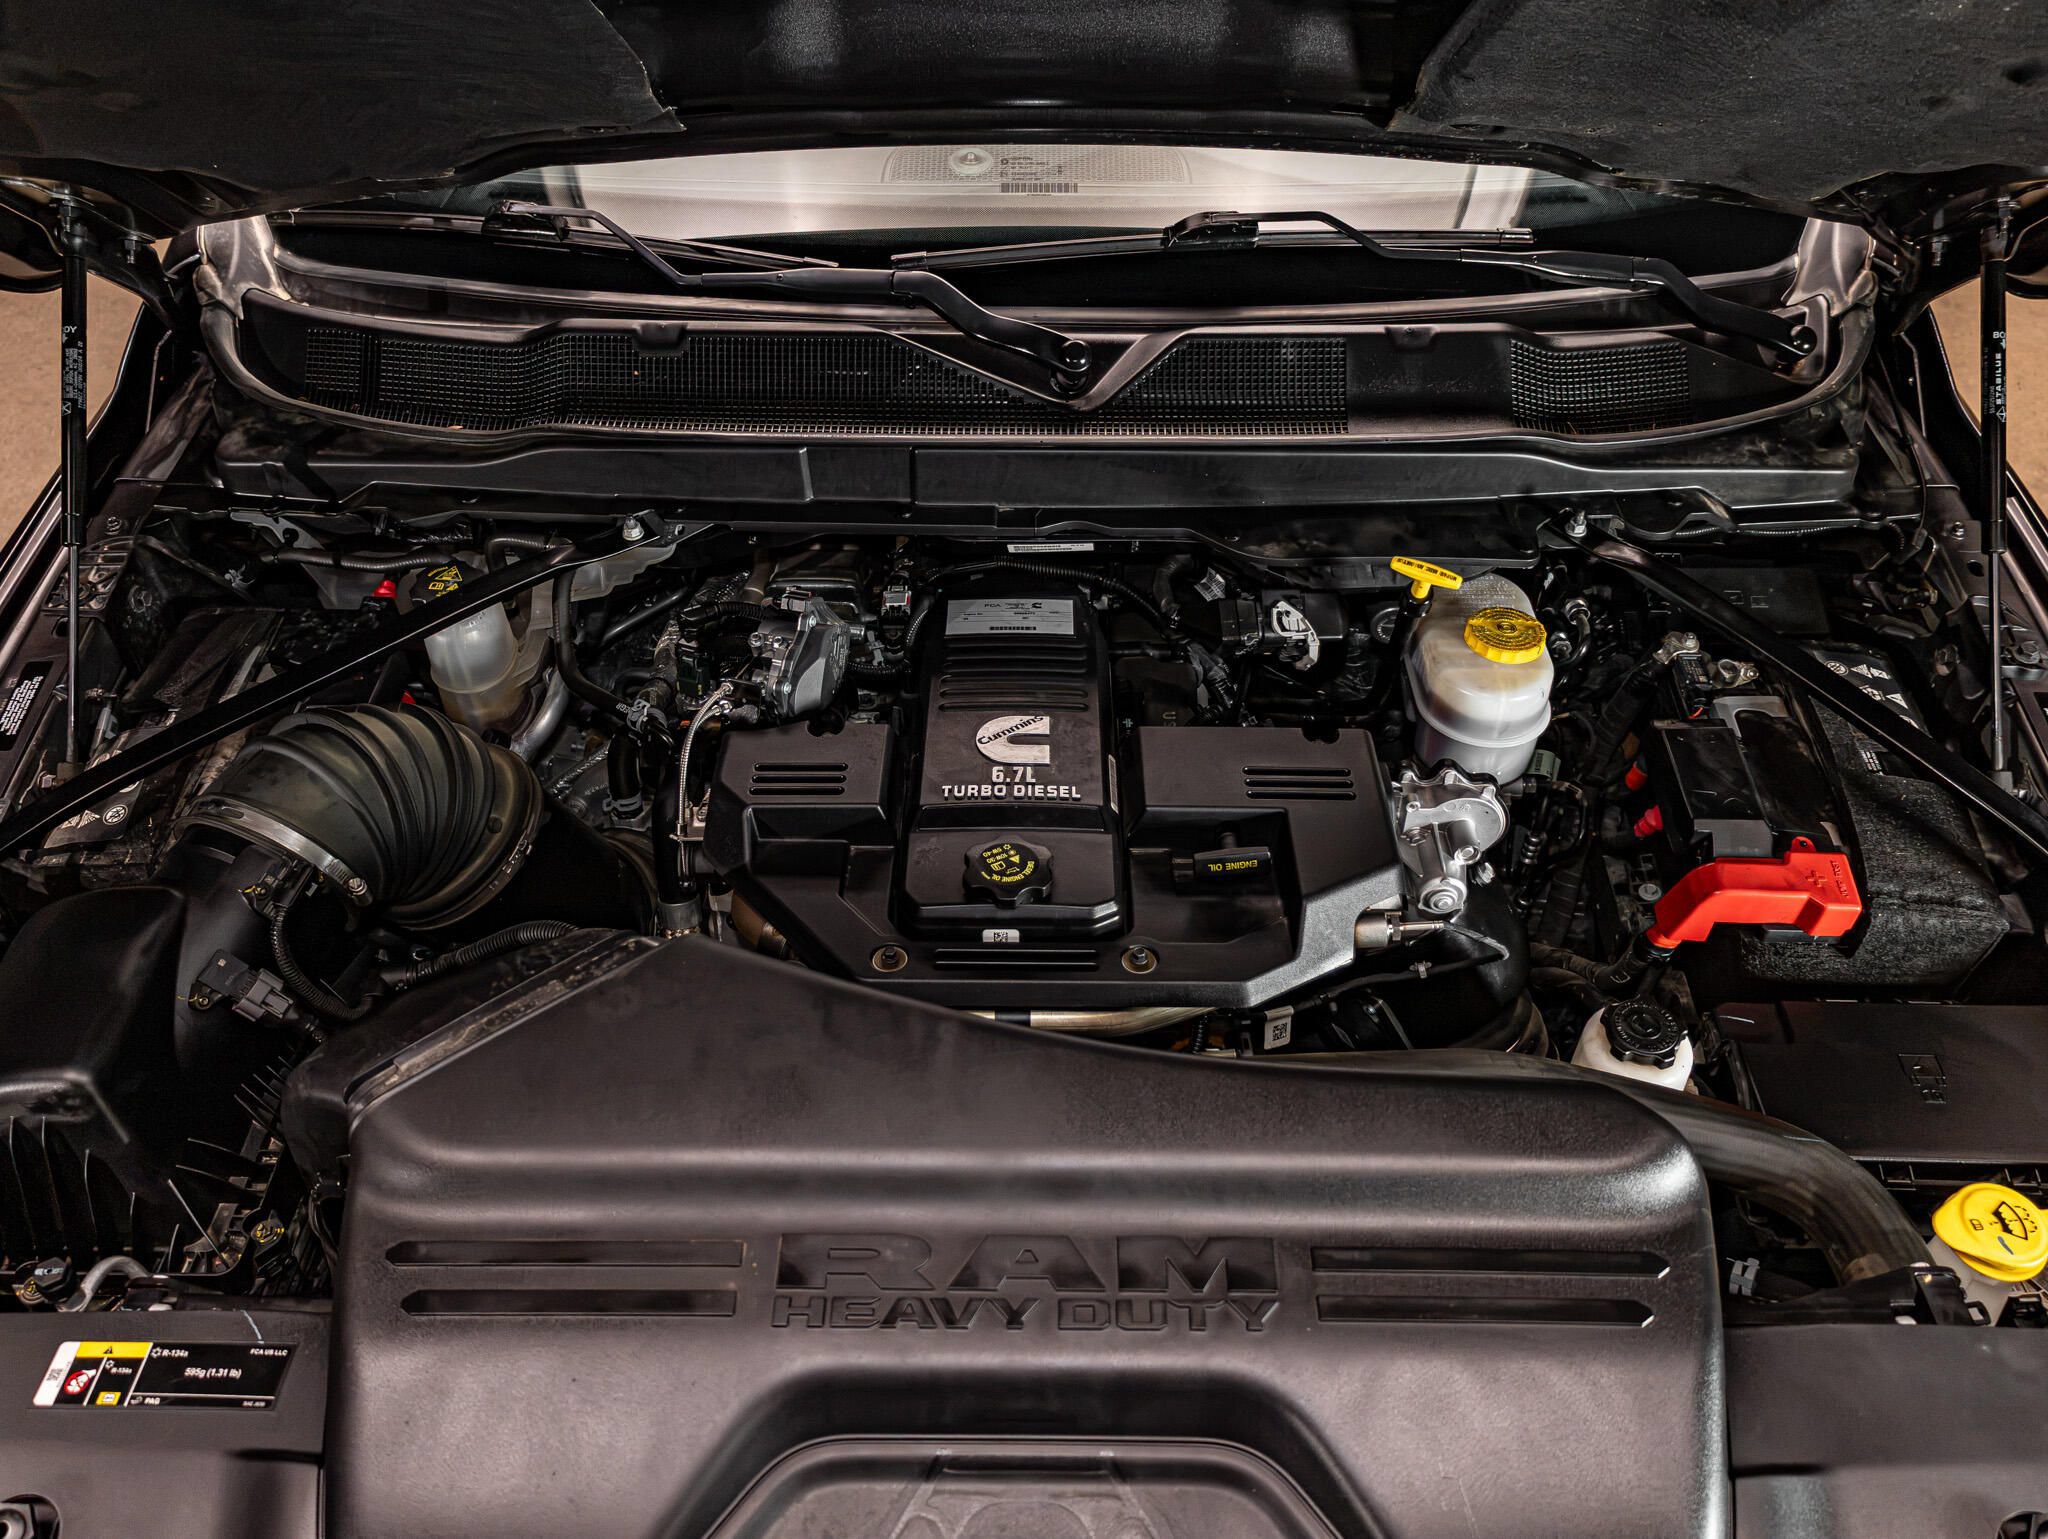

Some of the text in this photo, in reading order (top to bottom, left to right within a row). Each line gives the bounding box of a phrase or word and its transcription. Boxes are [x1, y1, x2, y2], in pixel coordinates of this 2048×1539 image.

[978, 715, 1044, 745] Cummins
[991, 766, 1036, 784] 6.7L
[942, 785, 1081, 799] TURBO DIESEL
[1208, 859, 1258, 872] ENGINE OIL
[1001, 873, 1025, 883] ENGINE
[776, 1233, 1279, 1295] RAM
[771, 1297, 1280, 1332] HEAVY DUTY
[162, 1349, 189, 1358] R-134a
[250, 1348, 264, 1356] FCA
[275, 1349, 288, 1357] LLC
[184, 1367, 242, 1379] 595g (1.31 lb)
[144, 1397, 160, 1405] PAG
